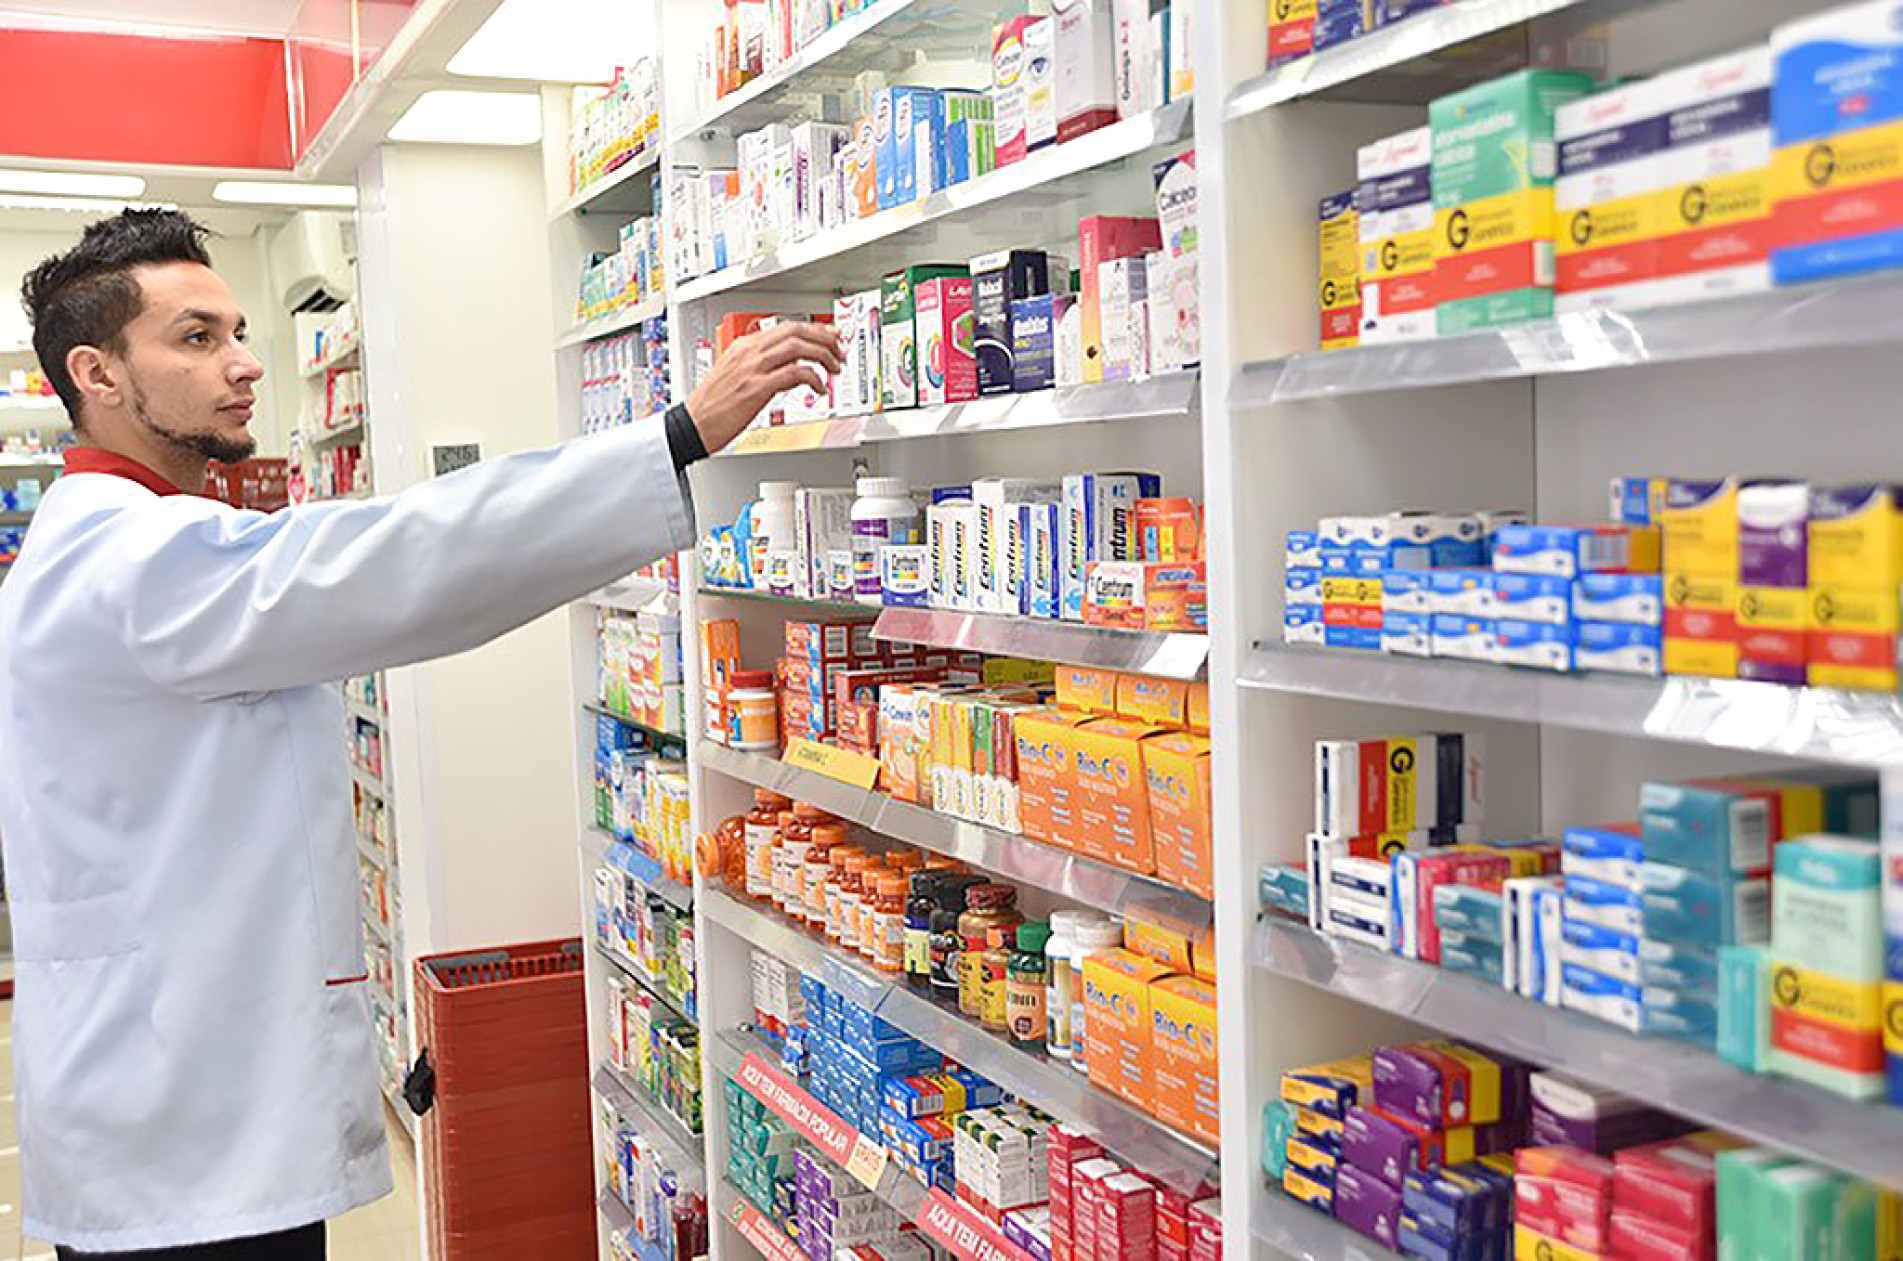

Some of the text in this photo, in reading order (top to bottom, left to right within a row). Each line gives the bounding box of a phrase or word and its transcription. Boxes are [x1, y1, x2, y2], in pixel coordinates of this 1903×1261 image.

[1681, 186, 1707, 224] G
[1447, 210, 1469, 249] G
[1571, 210, 1593, 246] G
[1382, 240, 1398, 271] G
[1322, 281, 1336, 306] G
[978, 504, 989, 590] Centrum
[1068, 507, 1077, 580] Centrum
[1110, 507, 1127, 560] ntrum
[931, 519, 941, 594] Centrum
[953, 520, 963, 596] Centrum
[1006, 519, 1016, 596] Centrum
[1096, 575, 1133, 598] Centrum
[1018, 738, 1051, 764] Bio-C
[1077, 751, 1114, 781] Bio-C
[1390, 747, 1415, 775] G
[1086, 980, 1122, 1013] Bio-C
[1154, 1009, 1197, 1046] Bio-C
[926, 1203, 959, 1237] AQUI
[951, 1221, 981, 1254] TEM
